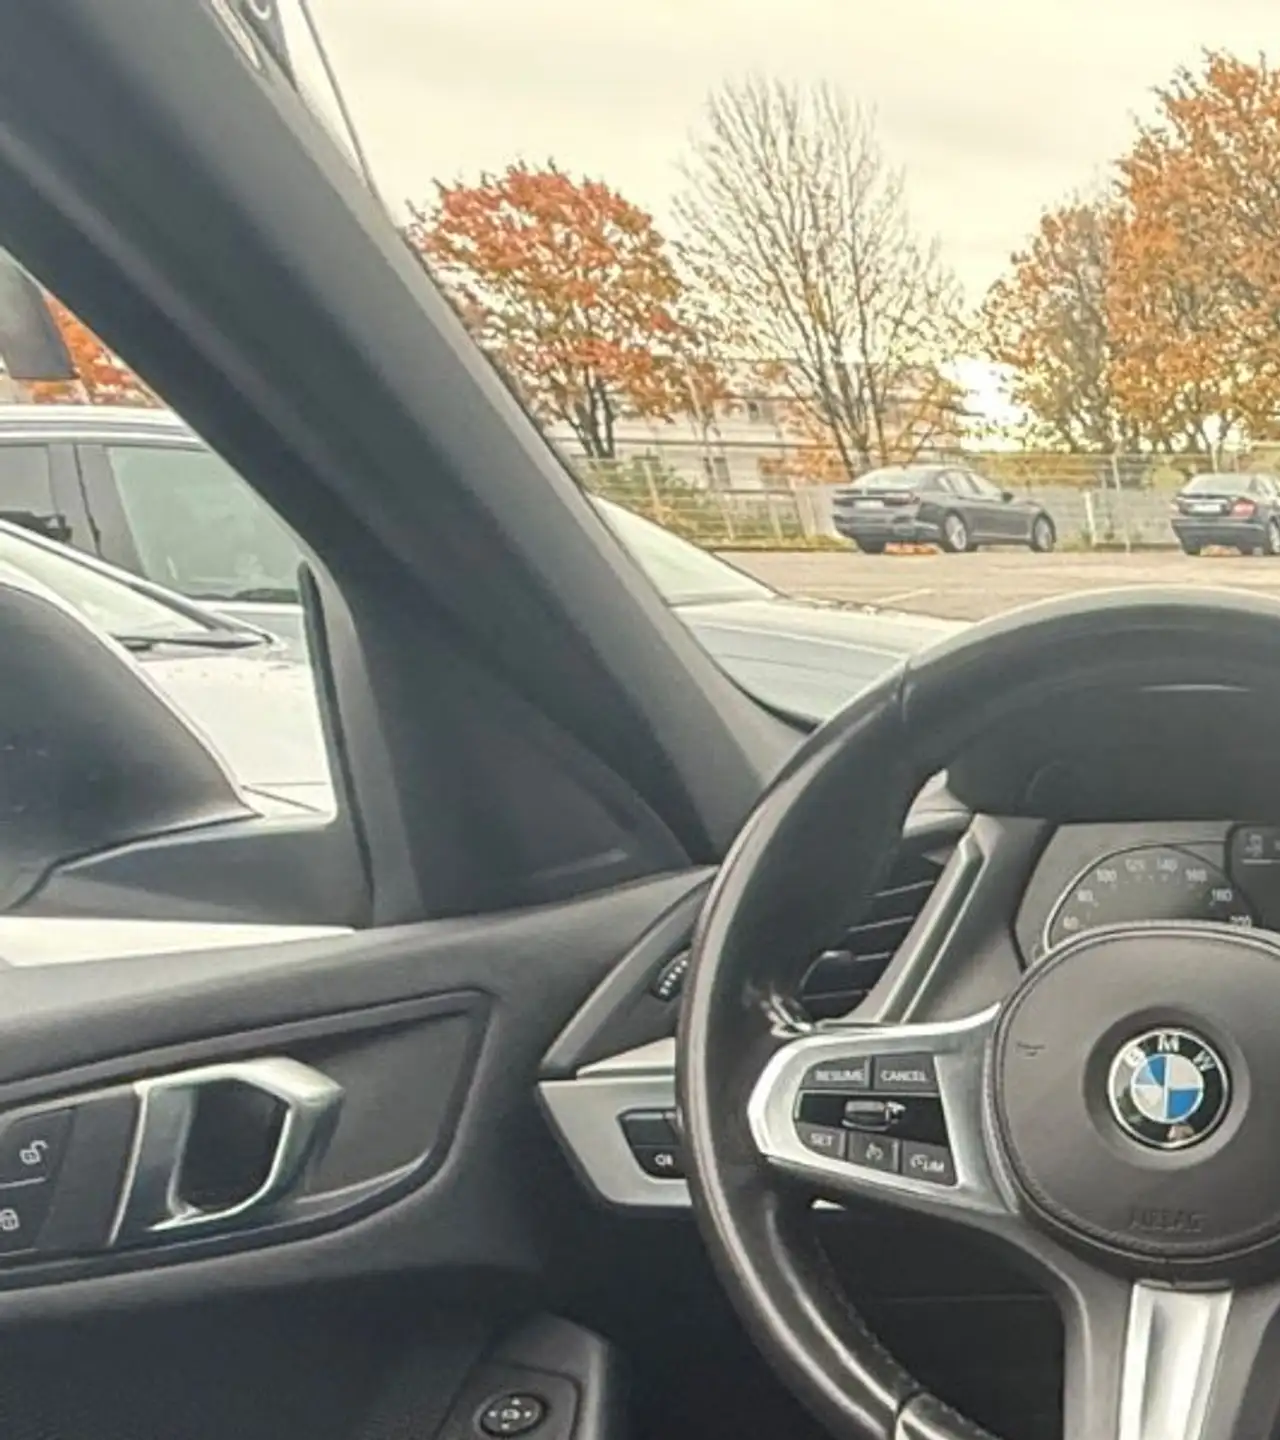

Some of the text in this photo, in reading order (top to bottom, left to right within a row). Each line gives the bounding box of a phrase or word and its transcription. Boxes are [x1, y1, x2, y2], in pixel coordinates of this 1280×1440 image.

[1124, 1034, 1215, 1072] BMW
[815, 1070, 864, 1082] RESUME
[880, 1070, 928, 1082] CANCEL
[810, 1133, 833, 1147] SET
